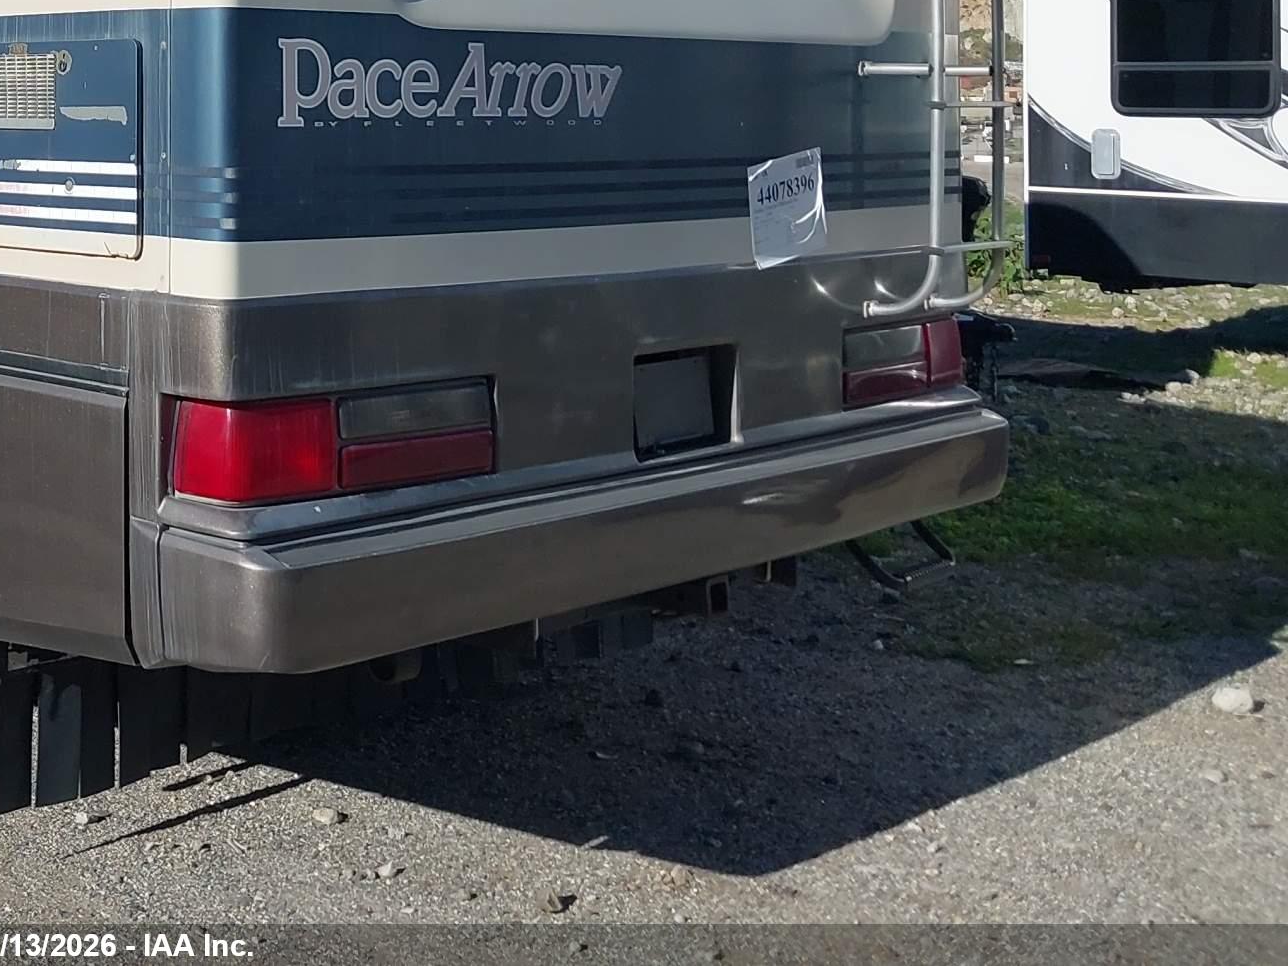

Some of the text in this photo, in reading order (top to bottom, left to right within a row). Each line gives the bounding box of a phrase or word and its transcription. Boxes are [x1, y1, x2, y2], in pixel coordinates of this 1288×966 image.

[277, 37, 623, 127] Pace Arrow
[363, 119, 602, 127] FLEETWOOD
[756, 174, 815, 205] 44078396
